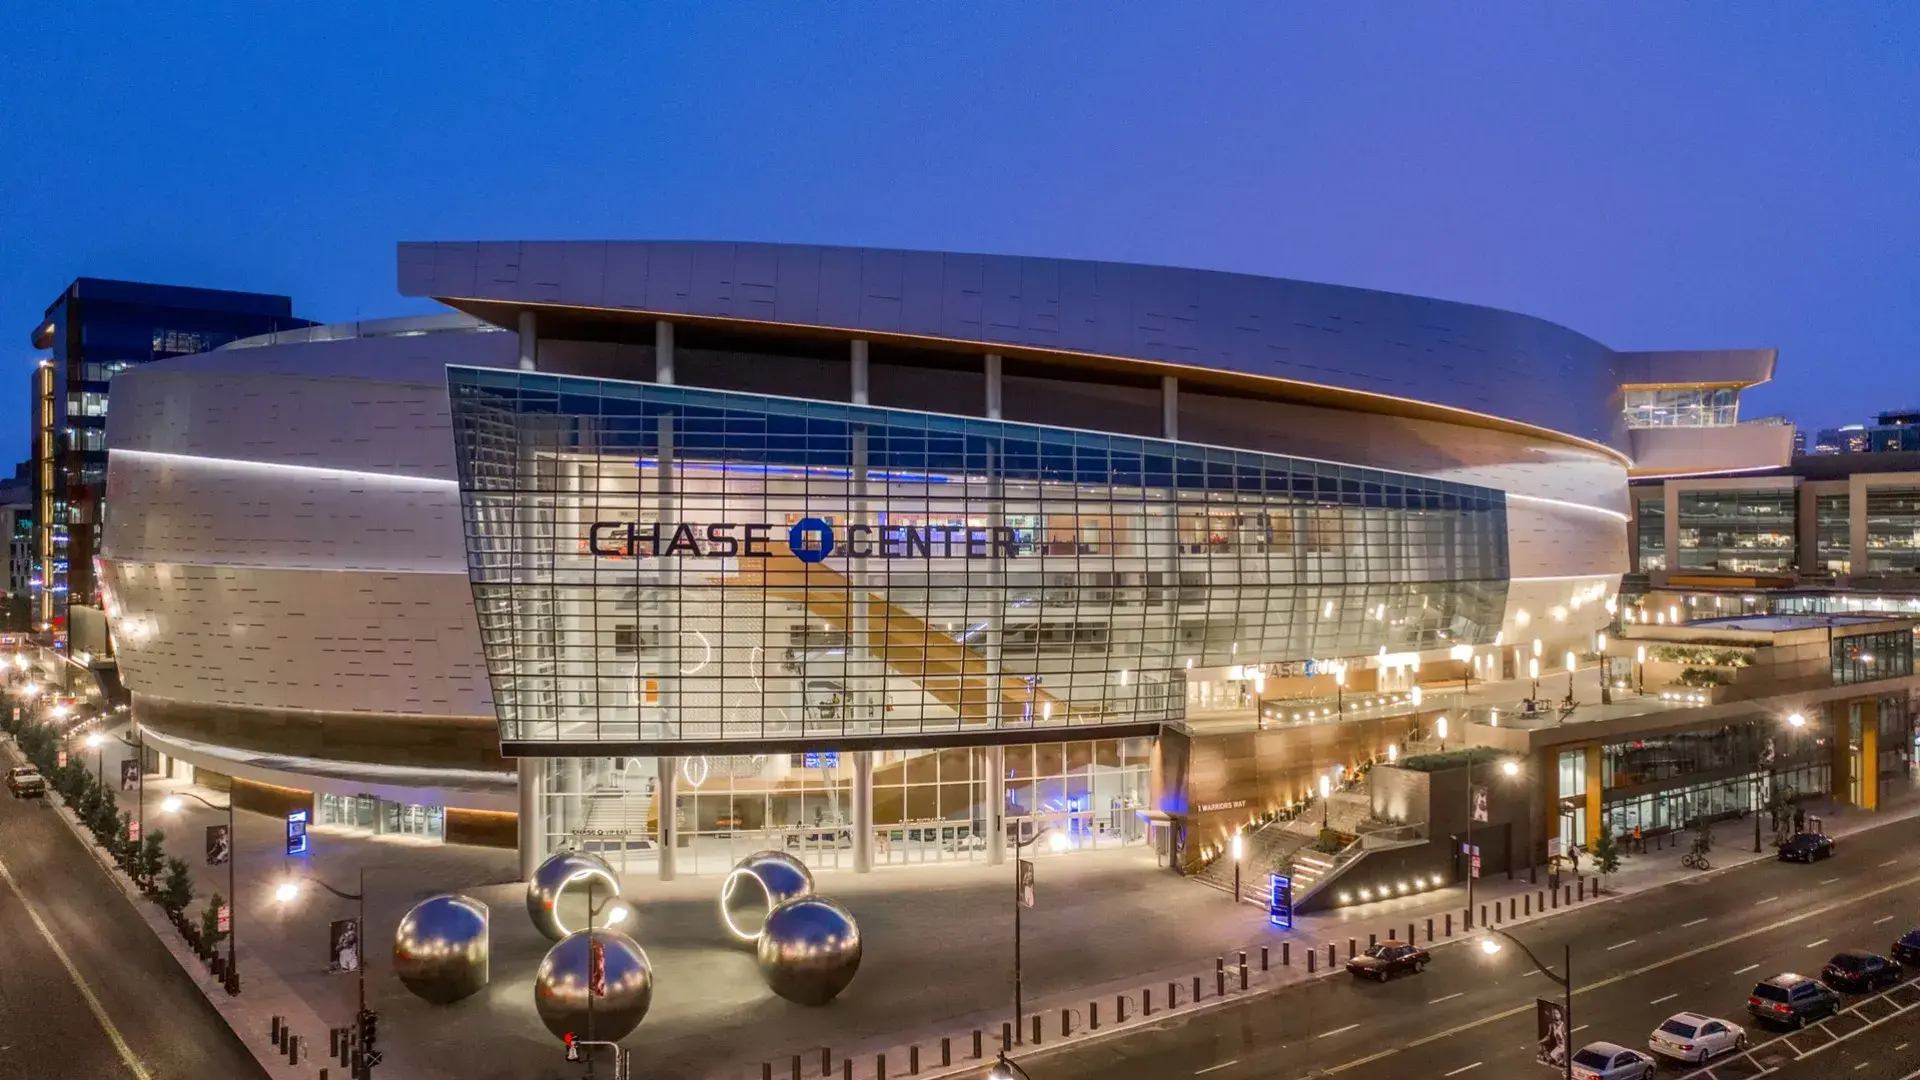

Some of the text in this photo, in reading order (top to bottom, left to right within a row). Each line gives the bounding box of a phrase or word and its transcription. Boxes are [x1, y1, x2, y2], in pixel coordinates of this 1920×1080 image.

[589, 522, 1018, 559] CHASE CENTER
[1201, 802, 1233, 812] WARRIORS
[1232, 800, 1247, 808] WAY
